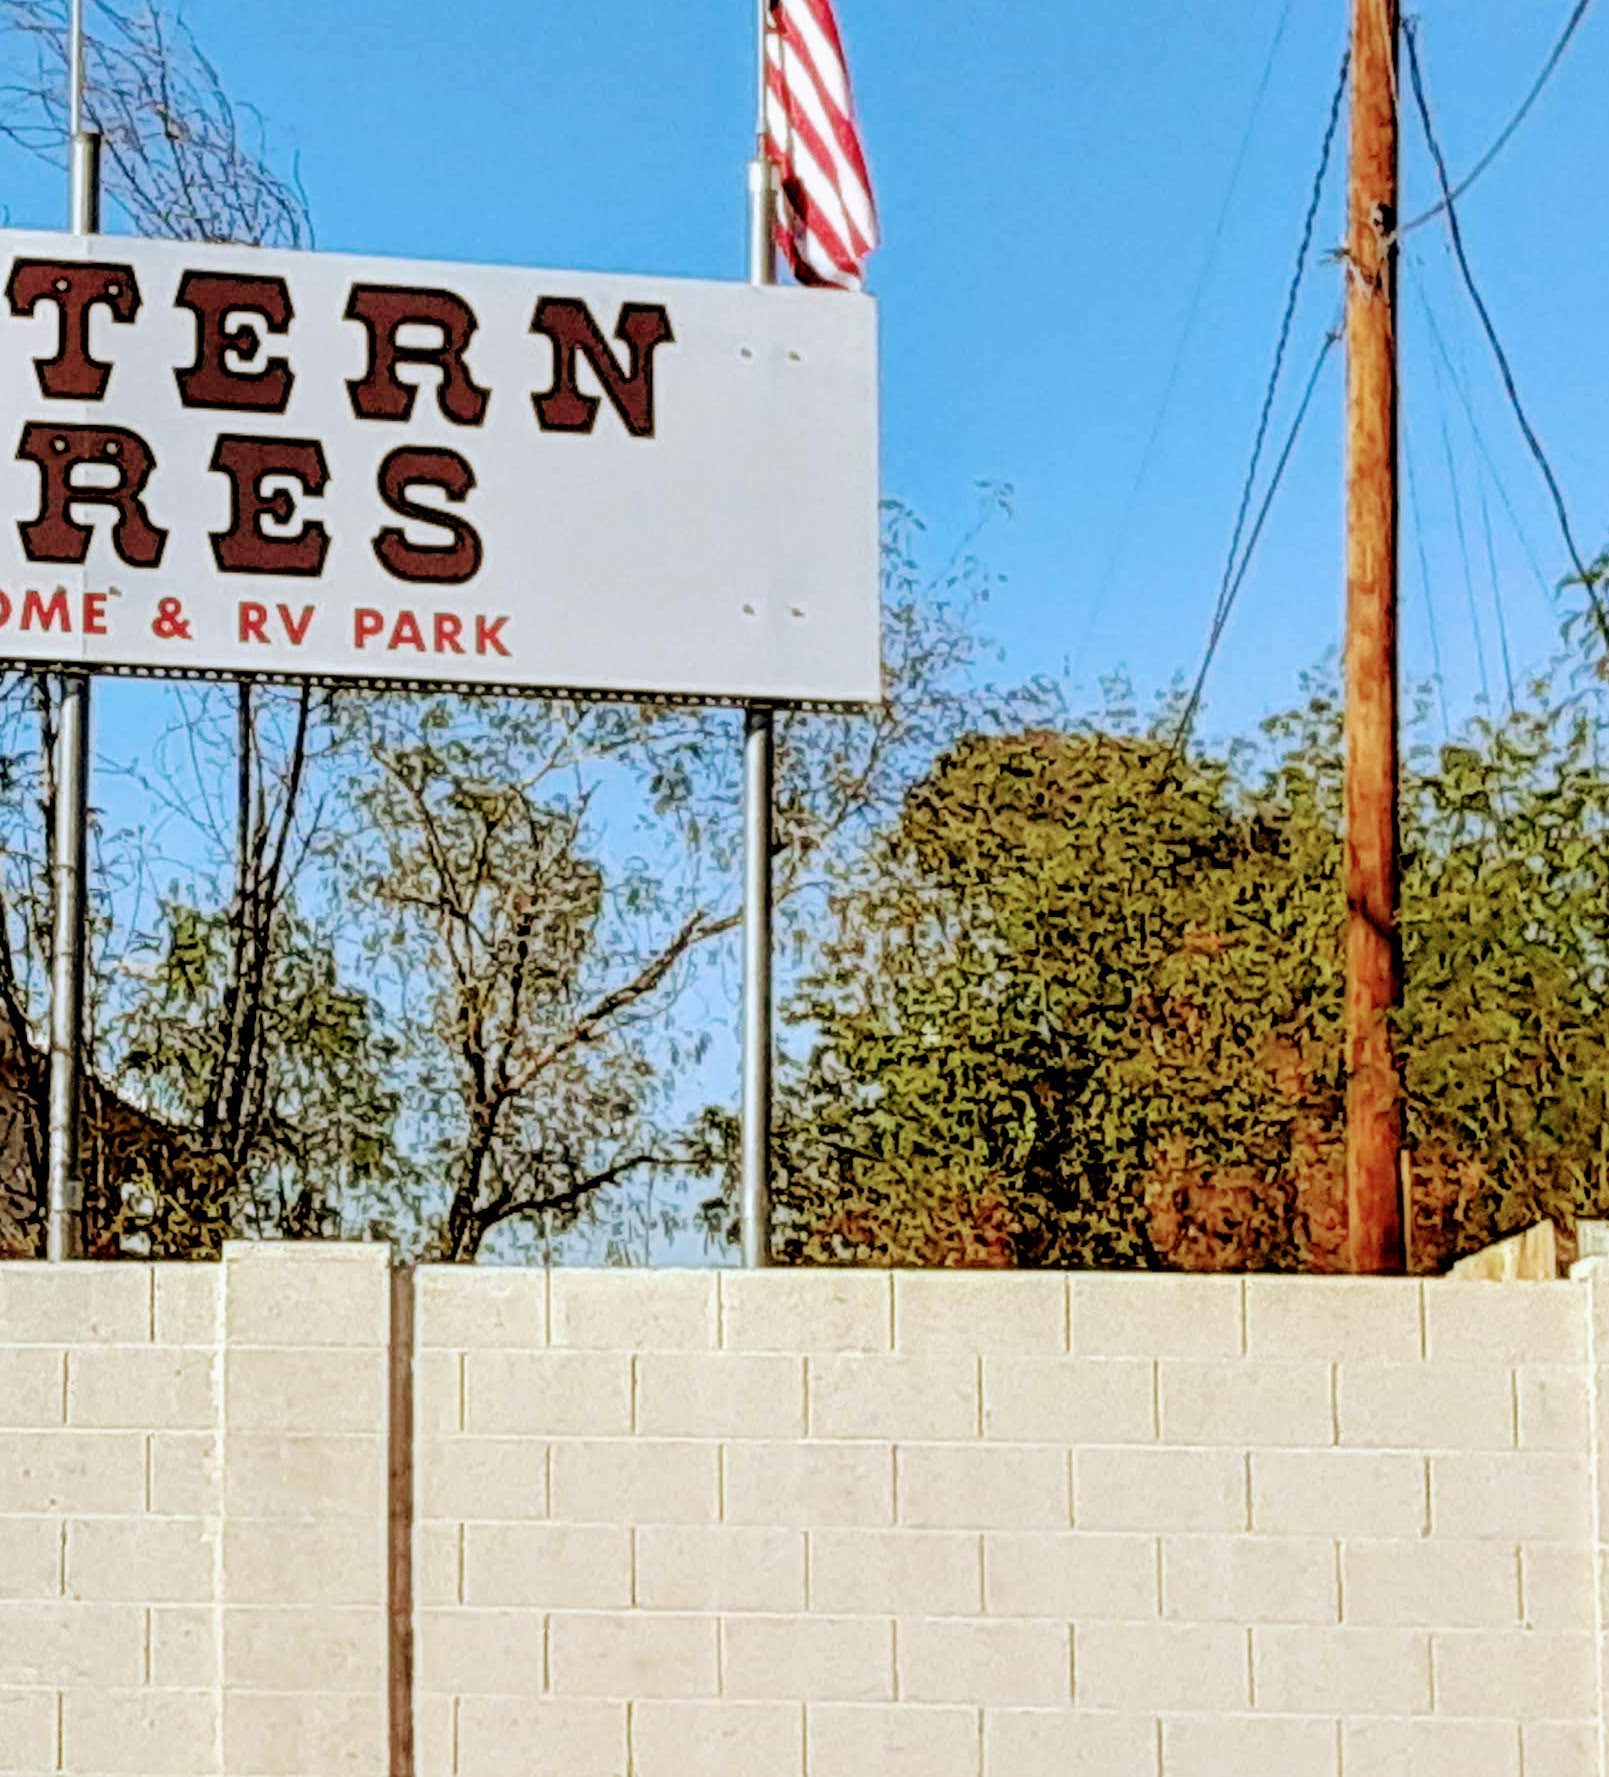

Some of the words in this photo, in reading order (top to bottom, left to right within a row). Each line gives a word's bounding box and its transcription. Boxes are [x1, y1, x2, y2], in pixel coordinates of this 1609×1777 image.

[150, 596, 192, 640] &
[238, 600, 316, 646] RV
[353, 607, 512, 657] PARK
